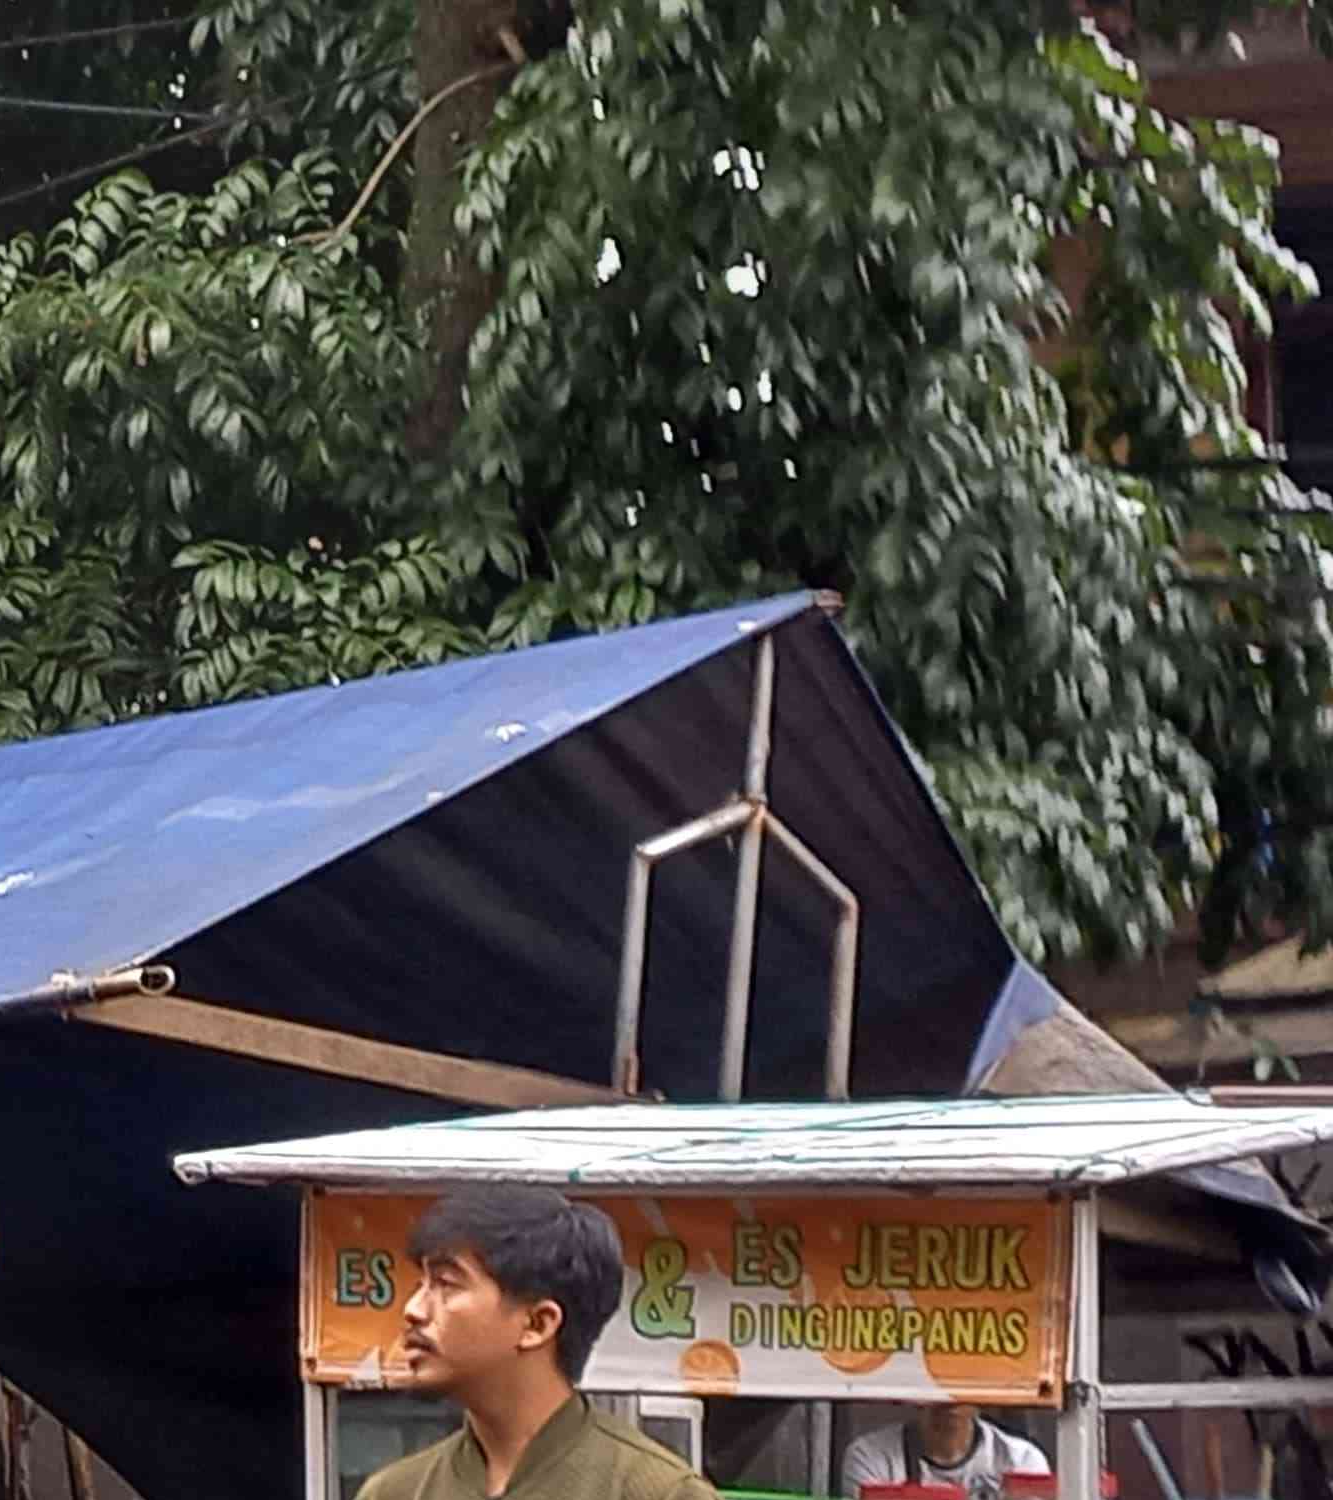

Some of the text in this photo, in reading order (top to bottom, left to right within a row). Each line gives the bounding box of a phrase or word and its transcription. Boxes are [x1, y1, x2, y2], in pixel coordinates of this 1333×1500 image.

[337, 1237, 695, 1339] ES &
[731, 1222, 1029, 1290] ES JERUK
[729, 1303, 1029, 1357] DINGIN&PANAS
